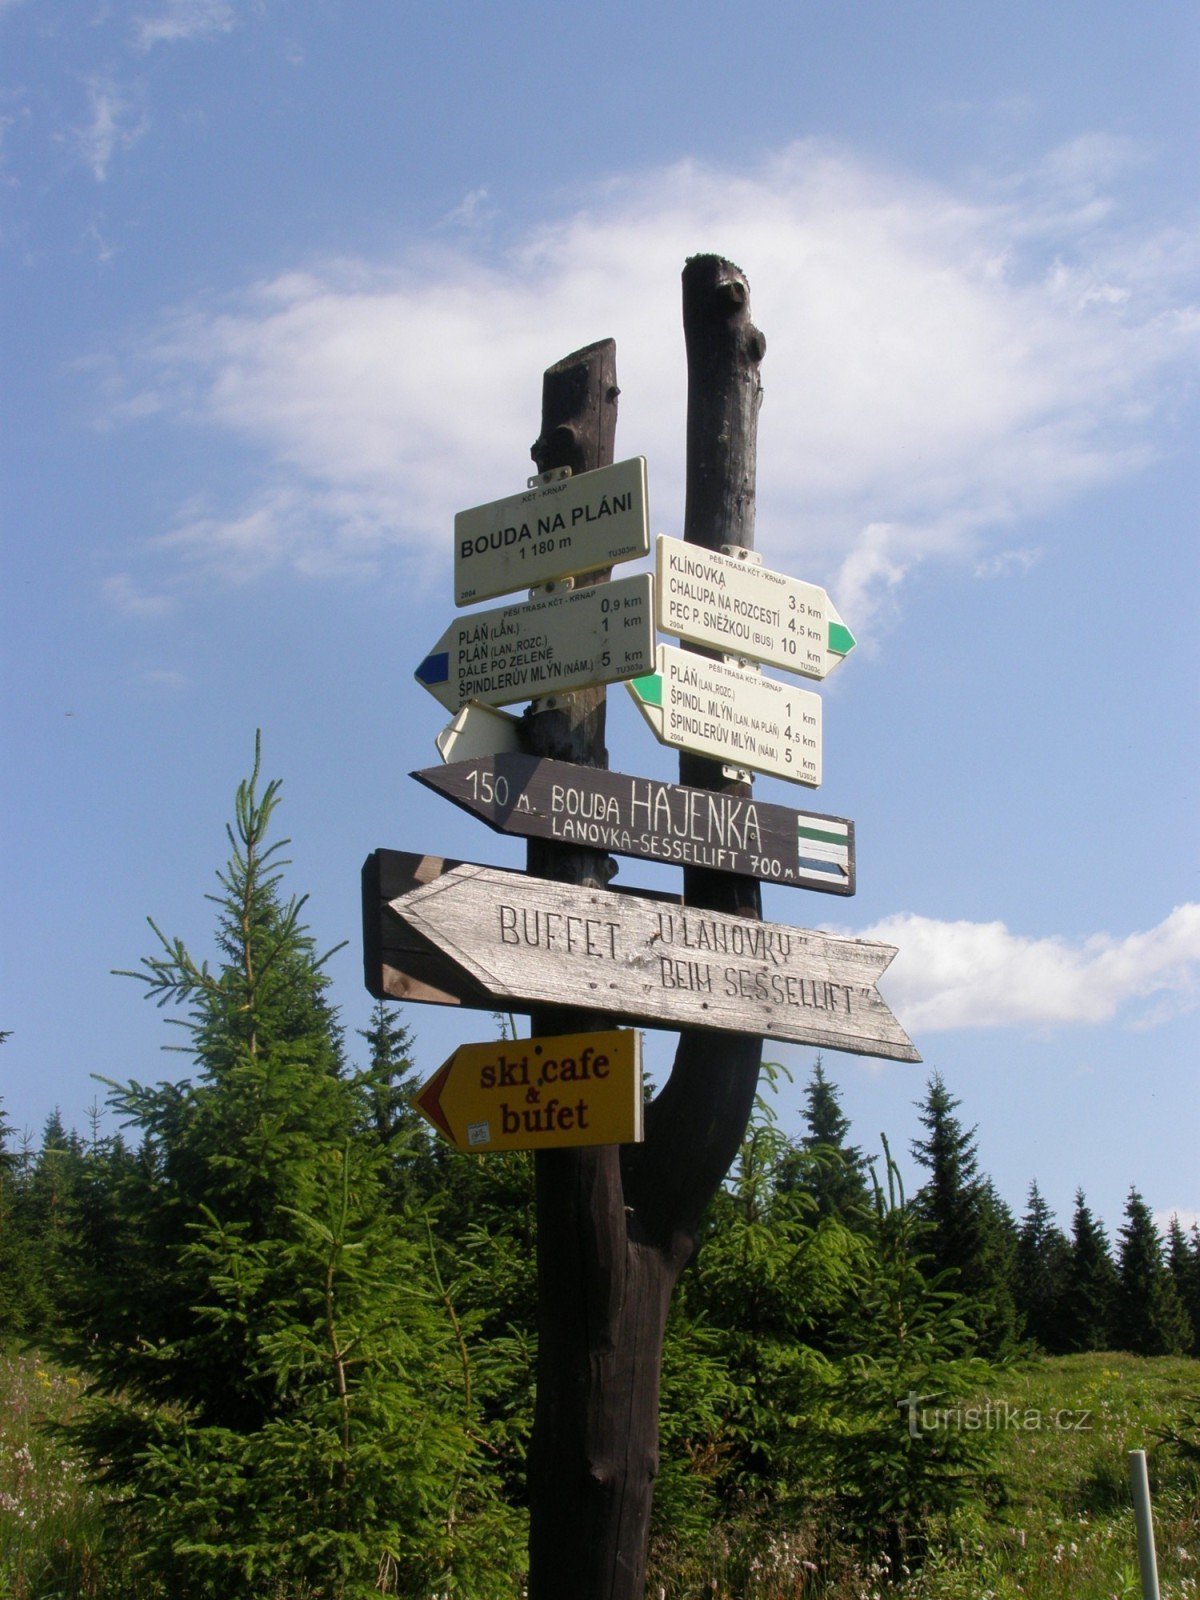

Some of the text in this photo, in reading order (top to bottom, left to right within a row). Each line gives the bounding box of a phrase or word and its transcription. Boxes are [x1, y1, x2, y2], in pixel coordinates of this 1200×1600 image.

[542, 484, 567, 498] KRNAP
[461, 492, 632, 558] BOUDA NA PLÁNI
[520, 536, 572, 559] 1 180 m
[669, 554, 822, 619] KLÍNOVKA 3,5 km
[709, 554, 724, 565] PĚŠÍ
[725, 561, 747, 573] TRASA
[749, 567, 761, 577] KČT
[764, 574, 787, 586] KRNAP
[461, 589, 476, 599] 2004
[522, 603, 546, 614] TRASA
[570, 591, 596, 601] KRNAP
[669, 578, 822, 641] CHALUPA NA ROZCESTÍ 4,5 km
[459, 623, 488, 646] PLÁŇ
[601, 598, 620, 613] 0,9
[624, 597, 642, 608] km
[669, 620, 684, 630] 2004
[669, 601, 821, 663] PEC P. SNĚŽKOU (BUS) 10 km
[459, 643, 488, 665] PLÁŇ
[602, 618, 609, 632] 1
[624, 616, 642, 628] km
[458, 647, 553, 678] DÁLE PO ZELENÉ
[531, 660, 562, 683] MLÝN
[563, 658, 594, 677] (NÁM.)
[601, 651, 611, 667] 5
[625, 651, 643, 662] km
[724, 668, 744, 680] TRASA
[745, 676, 758, 685] KČT
[761, 680, 783, 693] KRNAP
[670, 665, 698, 688] PLÁŇ
[785, 703, 792, 717] 1
[802, 713, 816, 726] km
[670, 685, 706, 714] ŠPINDL.
[708, 701, 733, 722] MLÝN
[751, 719, 760, 731] NA
[784, 725, 801, 743] 4,5
[802, 735, 816, 748] km
[670, 732, 684, 742] 2004
[731, 731, 756, 752] MLÝN
[758, 743, 778, 761] (NÁM.)
[784, 747, 793, 763] 5
[802, 757, 816, 770] km
[466, 769, 509, 806] 150
[551, 780, 762, 853] BOUDA HÁJENKA
[750, 855, 781, 877] 700
[500, 904, 620, 960] BUFFET
[480, 1047, 610, 1088] ski cafe
[525, 1086, 541, 1105] &
[501, 1099, 589, 1134] bufet
